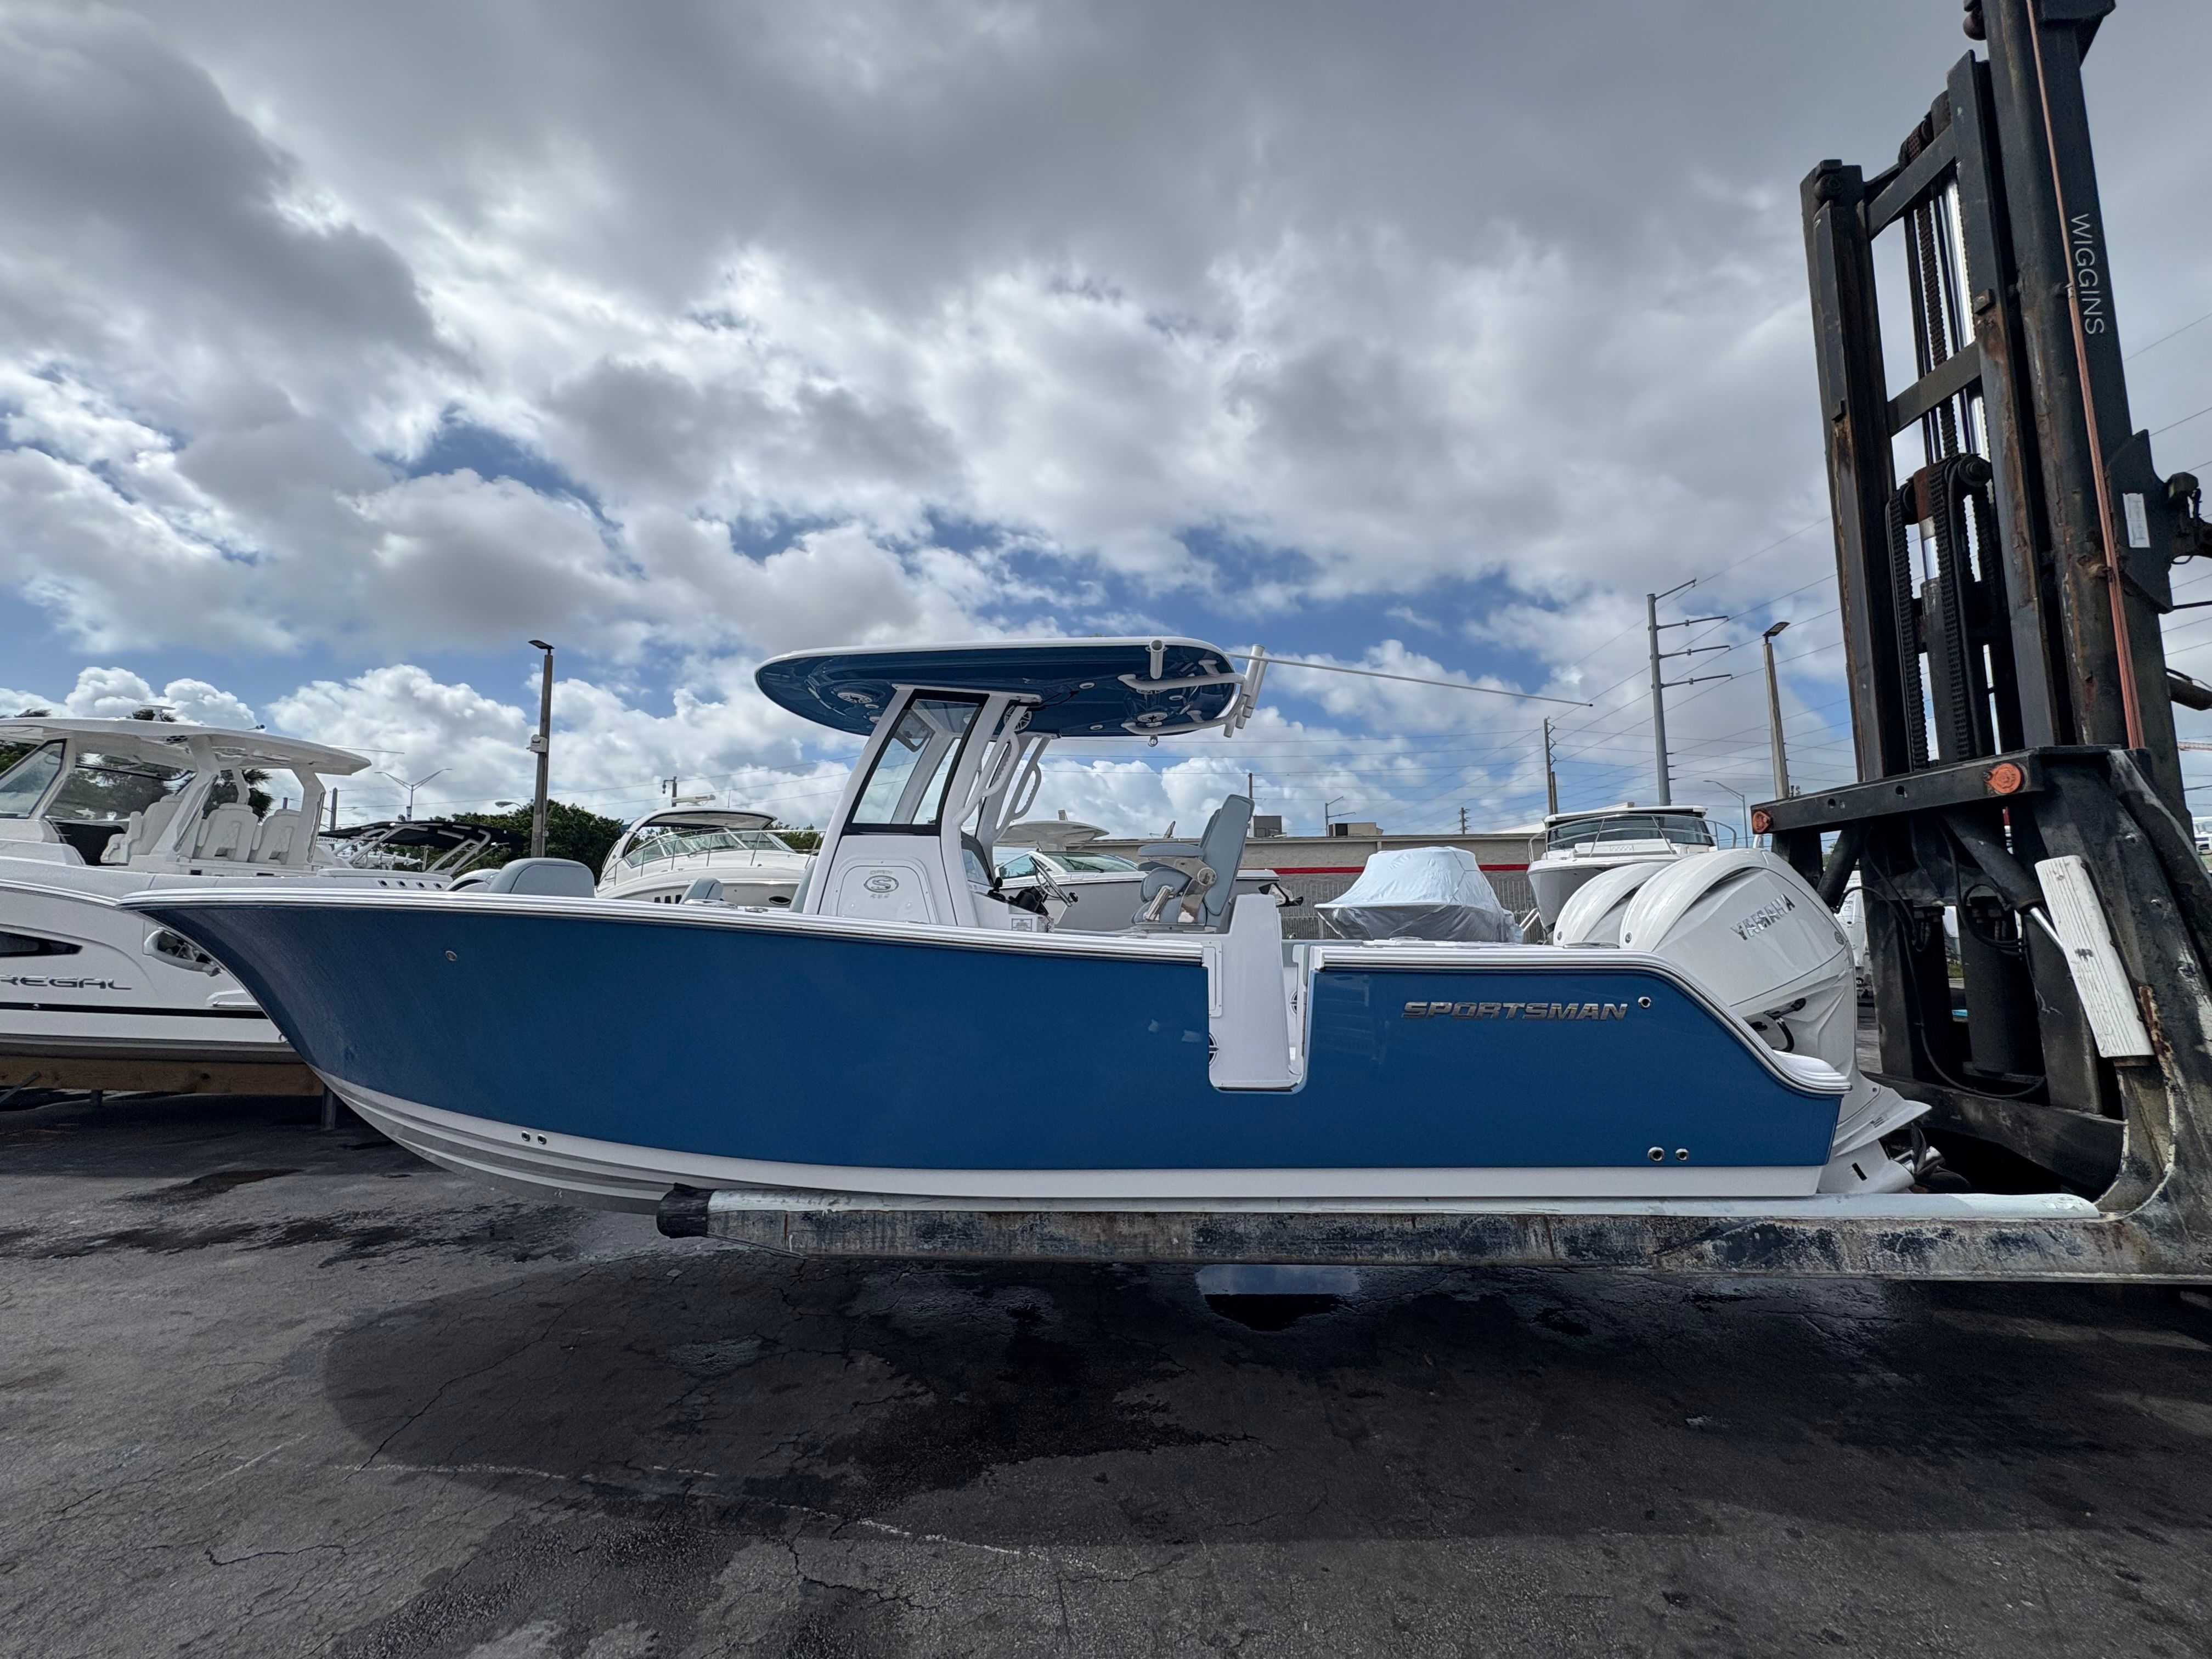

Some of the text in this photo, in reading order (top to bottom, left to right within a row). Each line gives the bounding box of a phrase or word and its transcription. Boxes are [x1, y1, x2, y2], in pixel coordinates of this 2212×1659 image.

[2071, 213, 2104, 335] WIGGINS
[1730, 893, 1796, 941] YAMAHA
[1401, 1001, 1628, 1020] SPORTSMAN
